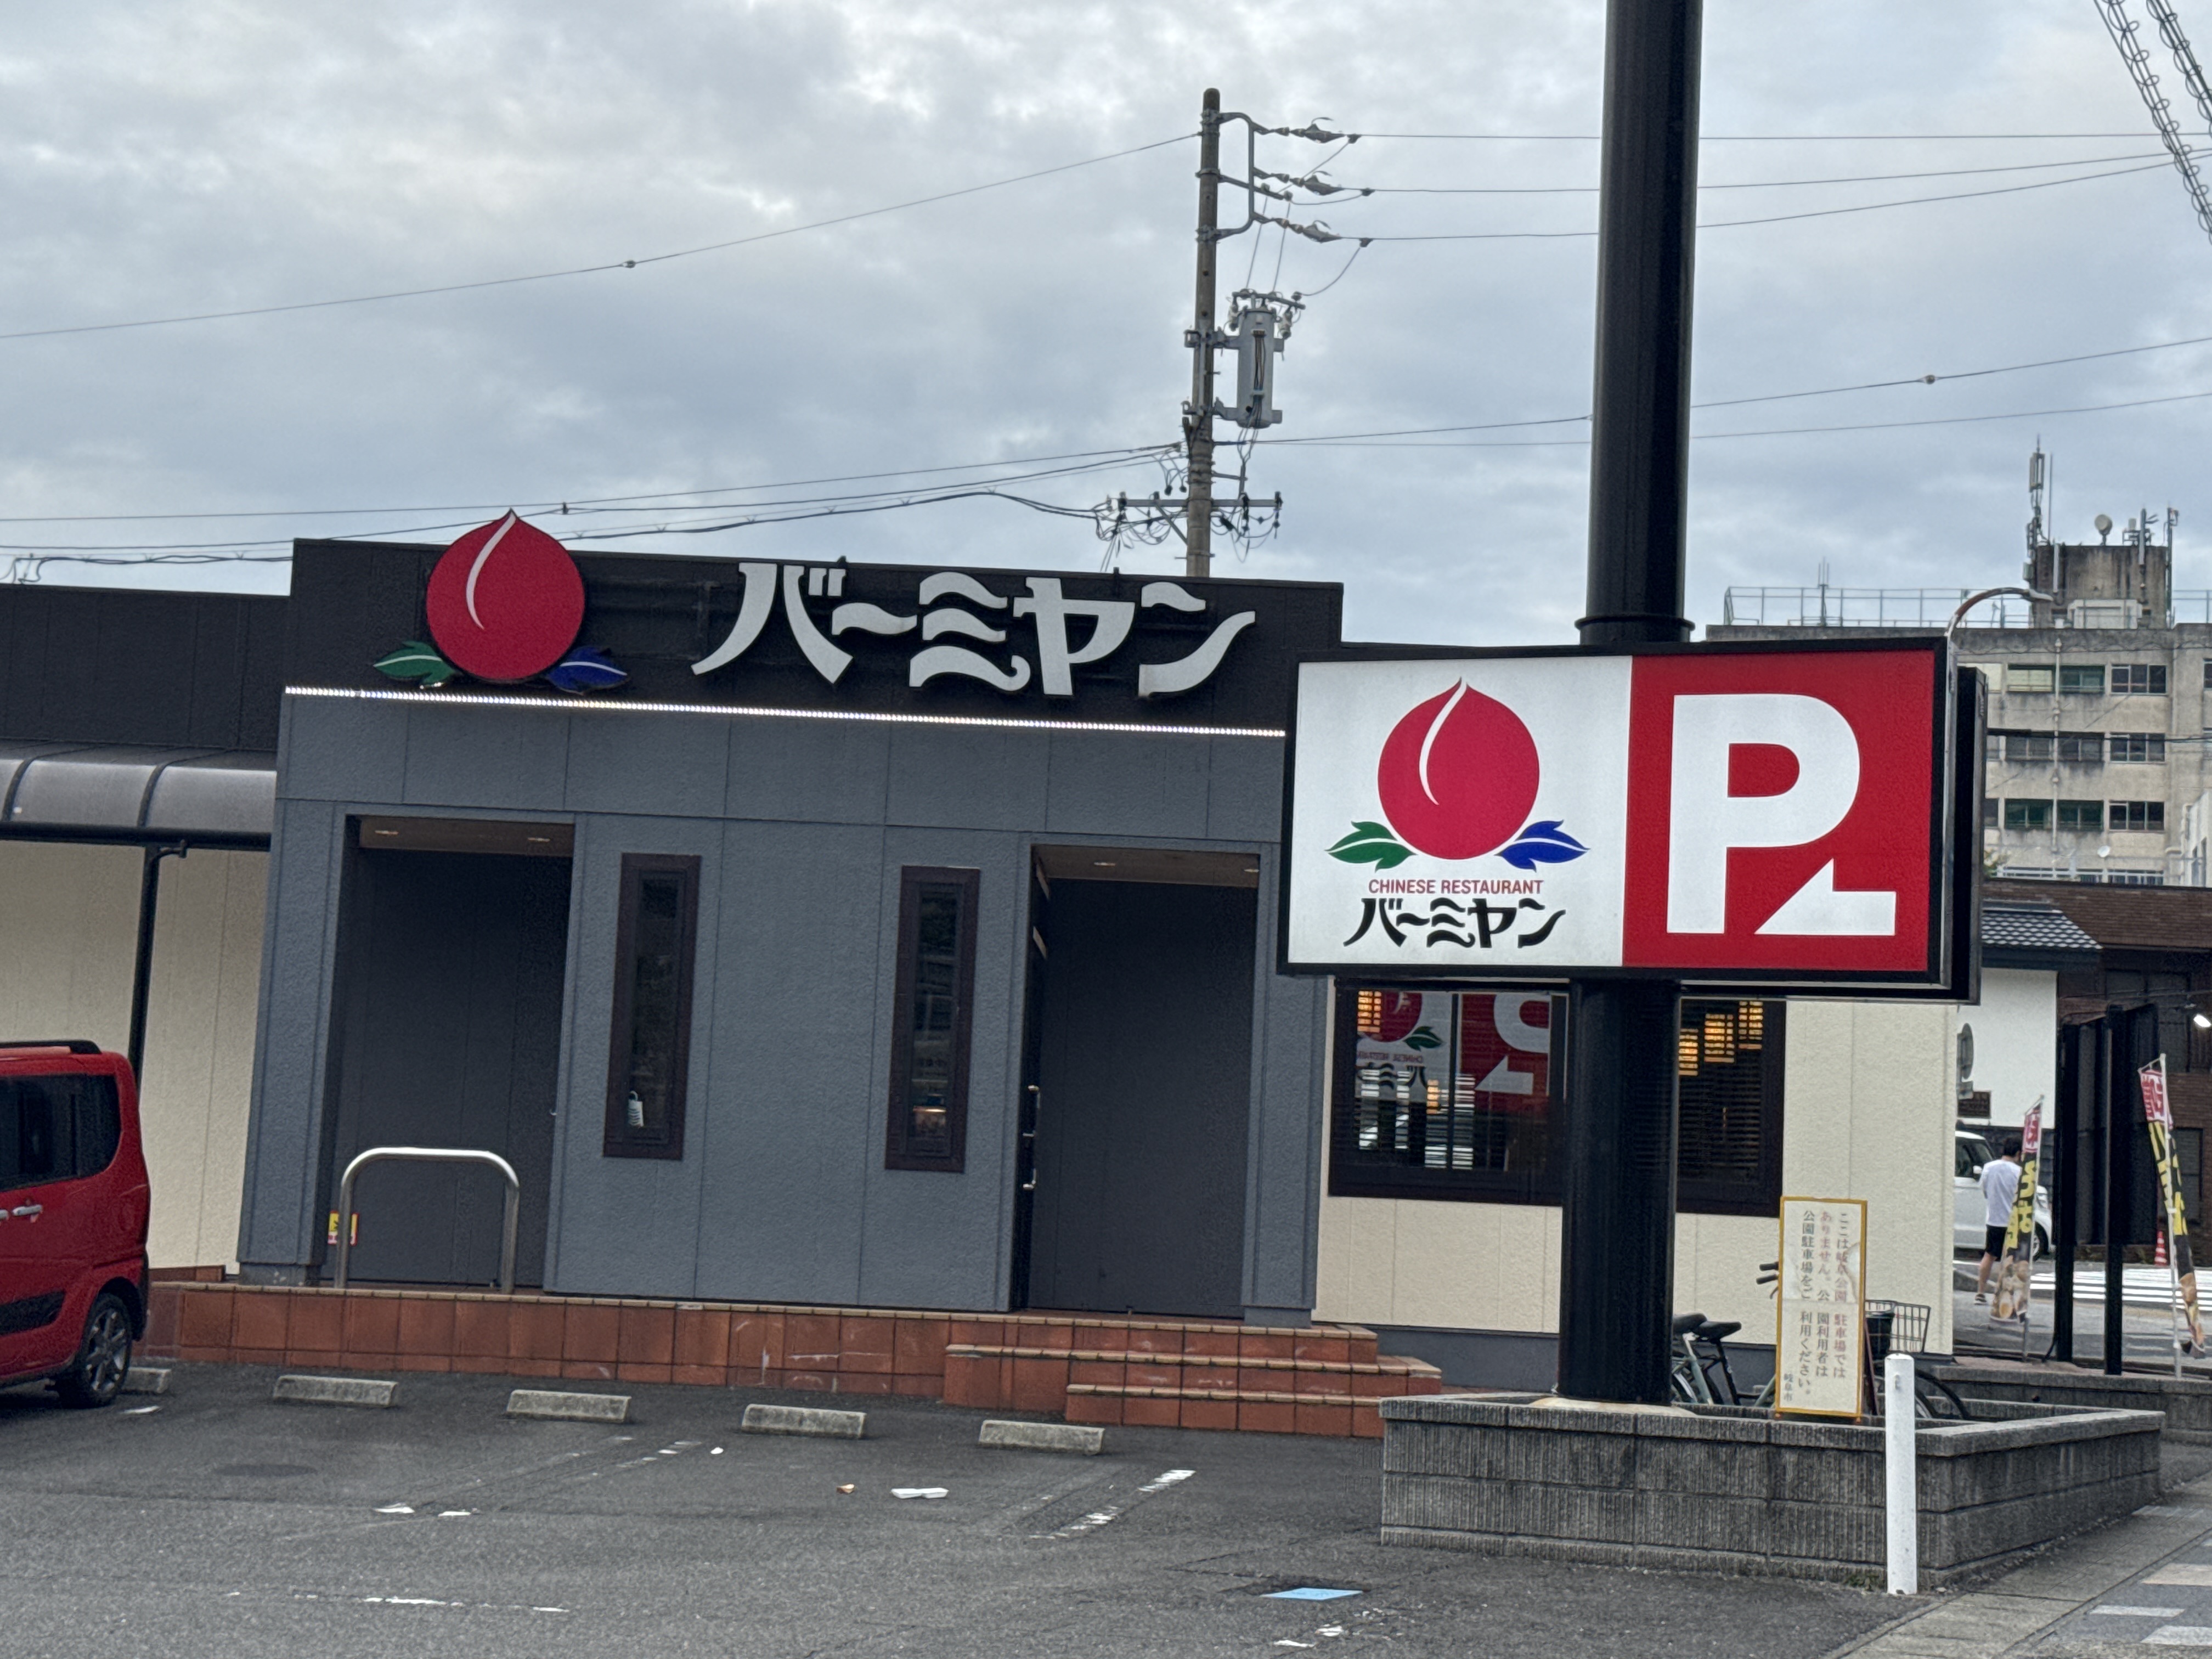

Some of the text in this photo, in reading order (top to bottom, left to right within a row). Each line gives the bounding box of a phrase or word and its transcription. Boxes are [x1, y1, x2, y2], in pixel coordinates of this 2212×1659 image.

[690, 562, 1256, 697] バーミヤン
[1665, 693, 1861, 934] P
[1343, 897, 1566, 949] バーミヤン
[1369, 879, 1544, 895] CHINESE RESTAURANT
